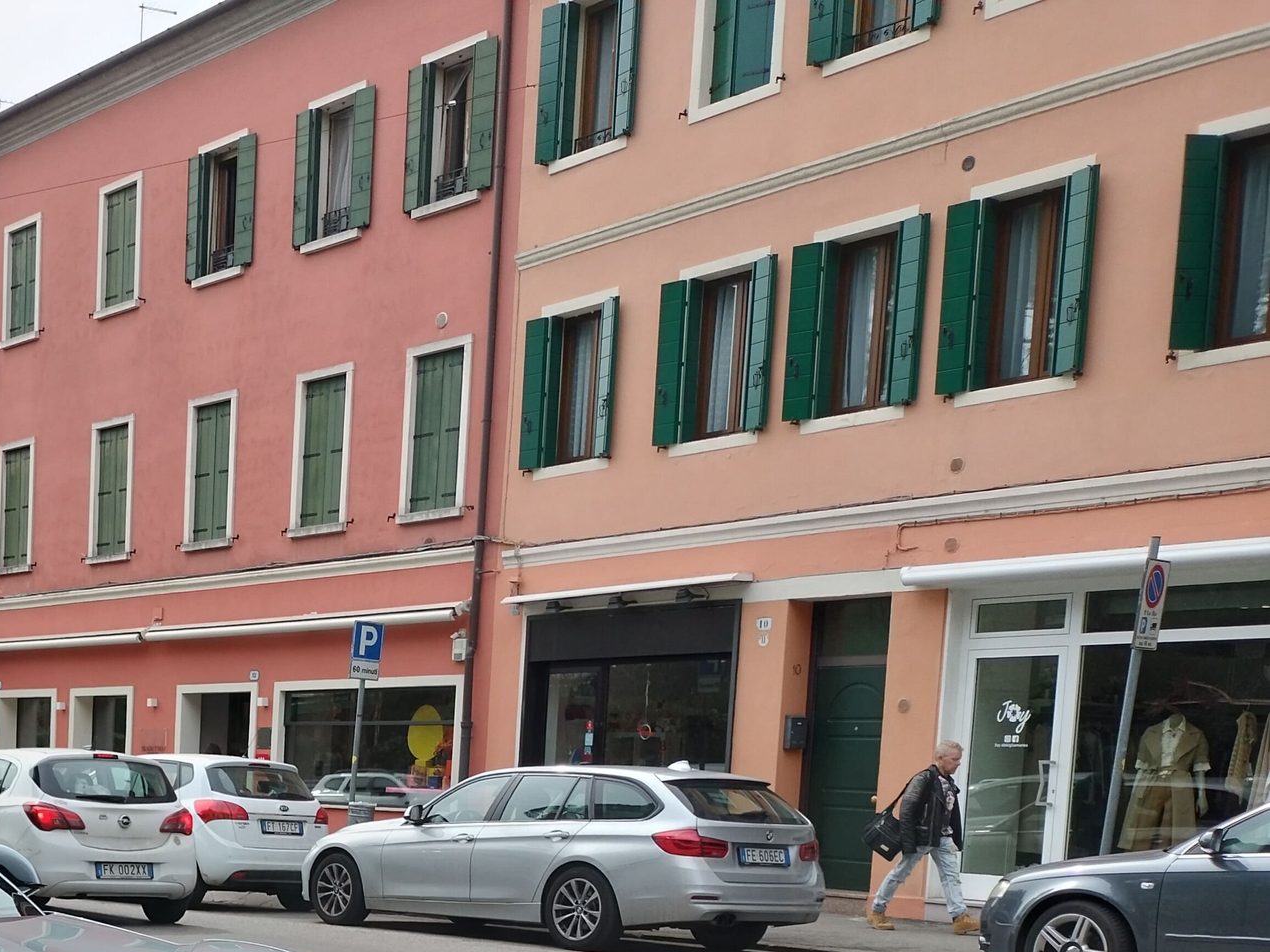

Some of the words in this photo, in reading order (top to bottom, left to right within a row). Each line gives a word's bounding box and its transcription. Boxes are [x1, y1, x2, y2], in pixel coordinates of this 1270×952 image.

[759, 620, 769, 629] 10
[359, 625, 378, 656] P
[352, 665, 361, 673] 60
[361, 667, 378, 676] minuti
[792, 663, 802, 676] 10
[996, 700, 1032, 734] Joy
[266, 821, 276, 832] FT
[278, 822, 299, 833] 167CF
[746, 849, 757, 862] FE
[758, 850, 784, 863] 606EC
[103, 864, 115, 875] FK
[118, 864, 147, 876] 002XX
